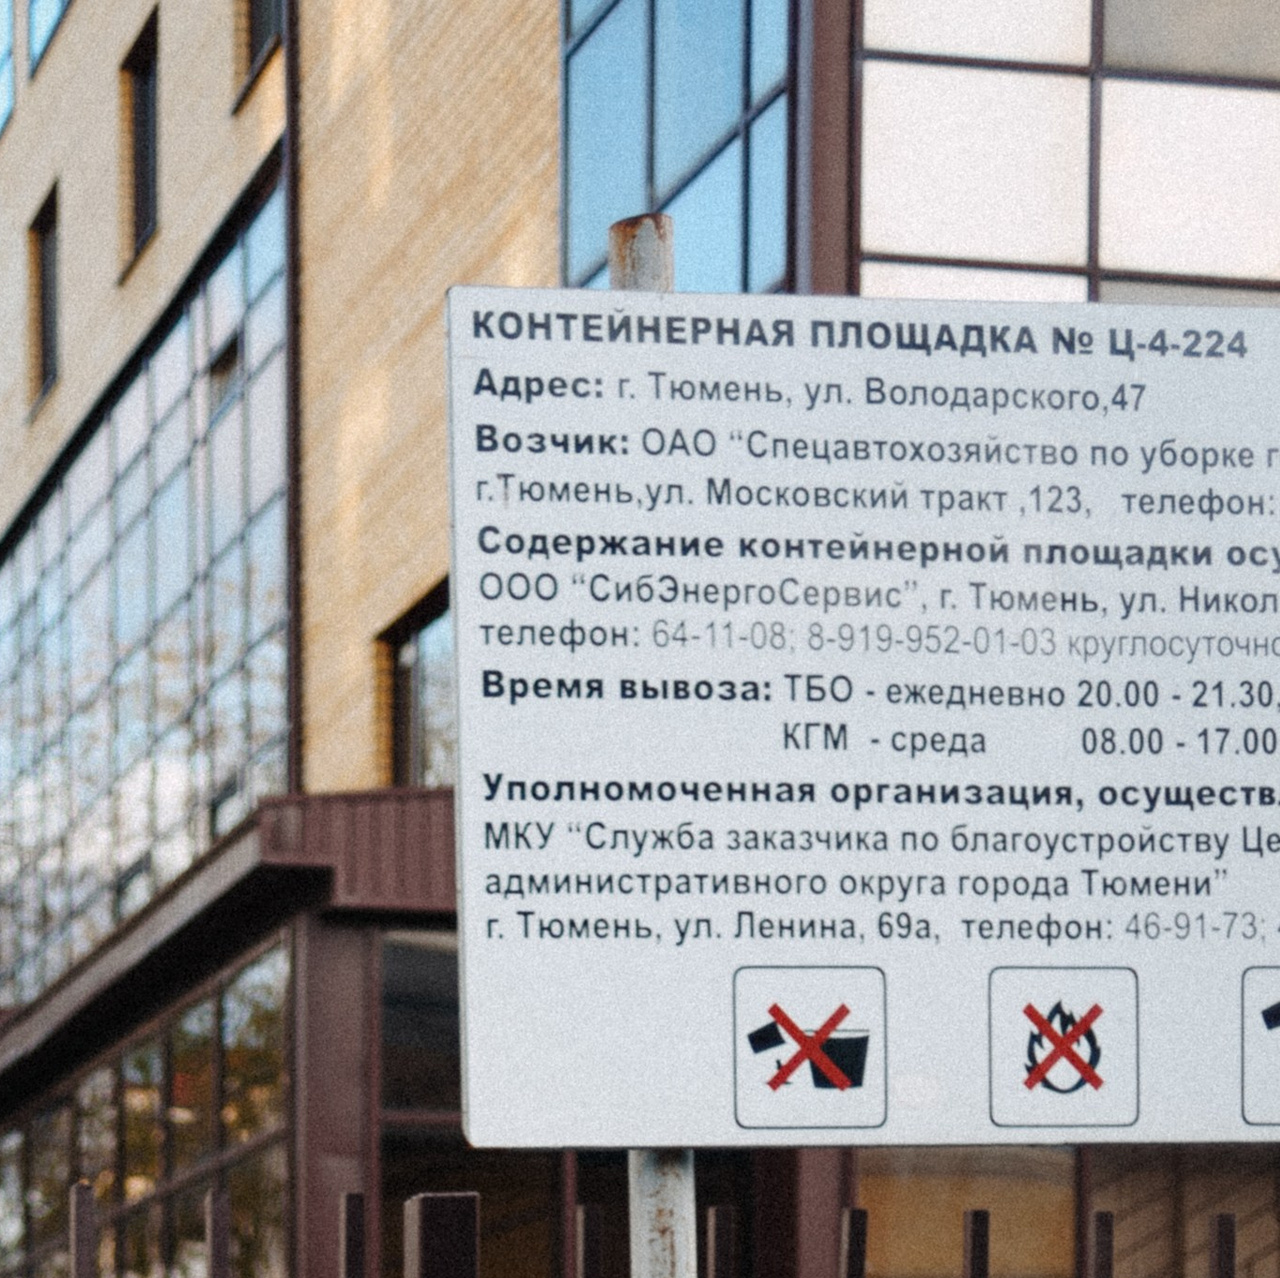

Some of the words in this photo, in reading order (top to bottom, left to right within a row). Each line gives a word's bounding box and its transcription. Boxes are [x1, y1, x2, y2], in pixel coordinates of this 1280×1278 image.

[472, 307, 795, 348] КОНТЕЙНЕРНАЯ
[810, 319, 1038, 358] ПЛОЩАДКА
[1051, 326, 1094, 355] №
[1108, 327, 1248, 363] Ц-4-224
[473, 367, 603, 407] Адрес:
[617, 377, 636, 400] г.
[647, 370, 792, 409] Тюмень,
[803, 382, 852, 412] ул.
[864, 375, 1147, 419] Володарского,47
[475, 423, 629, 456] Возчик:
[641, 426, 717, 458] ОАО
[1090, 444, 1130, 468] по
[1139, 437, 1255, 476] уборке
[706, 476, 908, 510] Московский
[919, 488, 1008, 518] тракт
[1121, 487, 1275, 522] телефон:
[477, 524, 725, 563] Содержание
[738, 532, 1009, 569] контейнерной
[1023, 543, 1213, 571] площадки
[479, 571, 559, 602] ООО
[939, 587, 957, 610] г.
[968, 581, 1108, 616] Тюмень,
[1119, 591, 1166, 621] ул.
[479, 617, 639, 654] телефон:
[807, 621, 1057, 657] 8-919-952-01-03
[481, 669, 604, 706] Время
[619, 678, 772, 702] вывоза:
[783, 672, 854, 704] ТБО
[885, 682, 1066, 710] ежедневно
[1076, 678, 1160, 709] 20.00
[782, 721, 848, 751] КГМ
[890, 730, 987, 760] среда
[1081, 726, 1164, 756] 08.00
[1197, 726, 1278, 756] 17.00
[482, 772, 816, 803] Уполномоченная
[829, 782, 1084, 812] организация,
[1097, 785, 1280, 814] осуществ
[484, 821, 555, 850] МКУ
[726, 828, 889, 852] заказчика
[900, 830, 940, 853] по
[950, 823, 1230, 861] благоустройству
[485, 873, 828, 902] административного
[839, 873, 947, 904] округа
[958, 874, 1070, 904] города
[486, 917, 504, 940] г.
[515, 909, 662, 945] Тюмень,
[673, 917, 722, 948] ул.
[733, 909, 865, 945] Ленина,
[876, 910, 940, 946] 69а,
[960, 912, 1112, 948] телефон:
